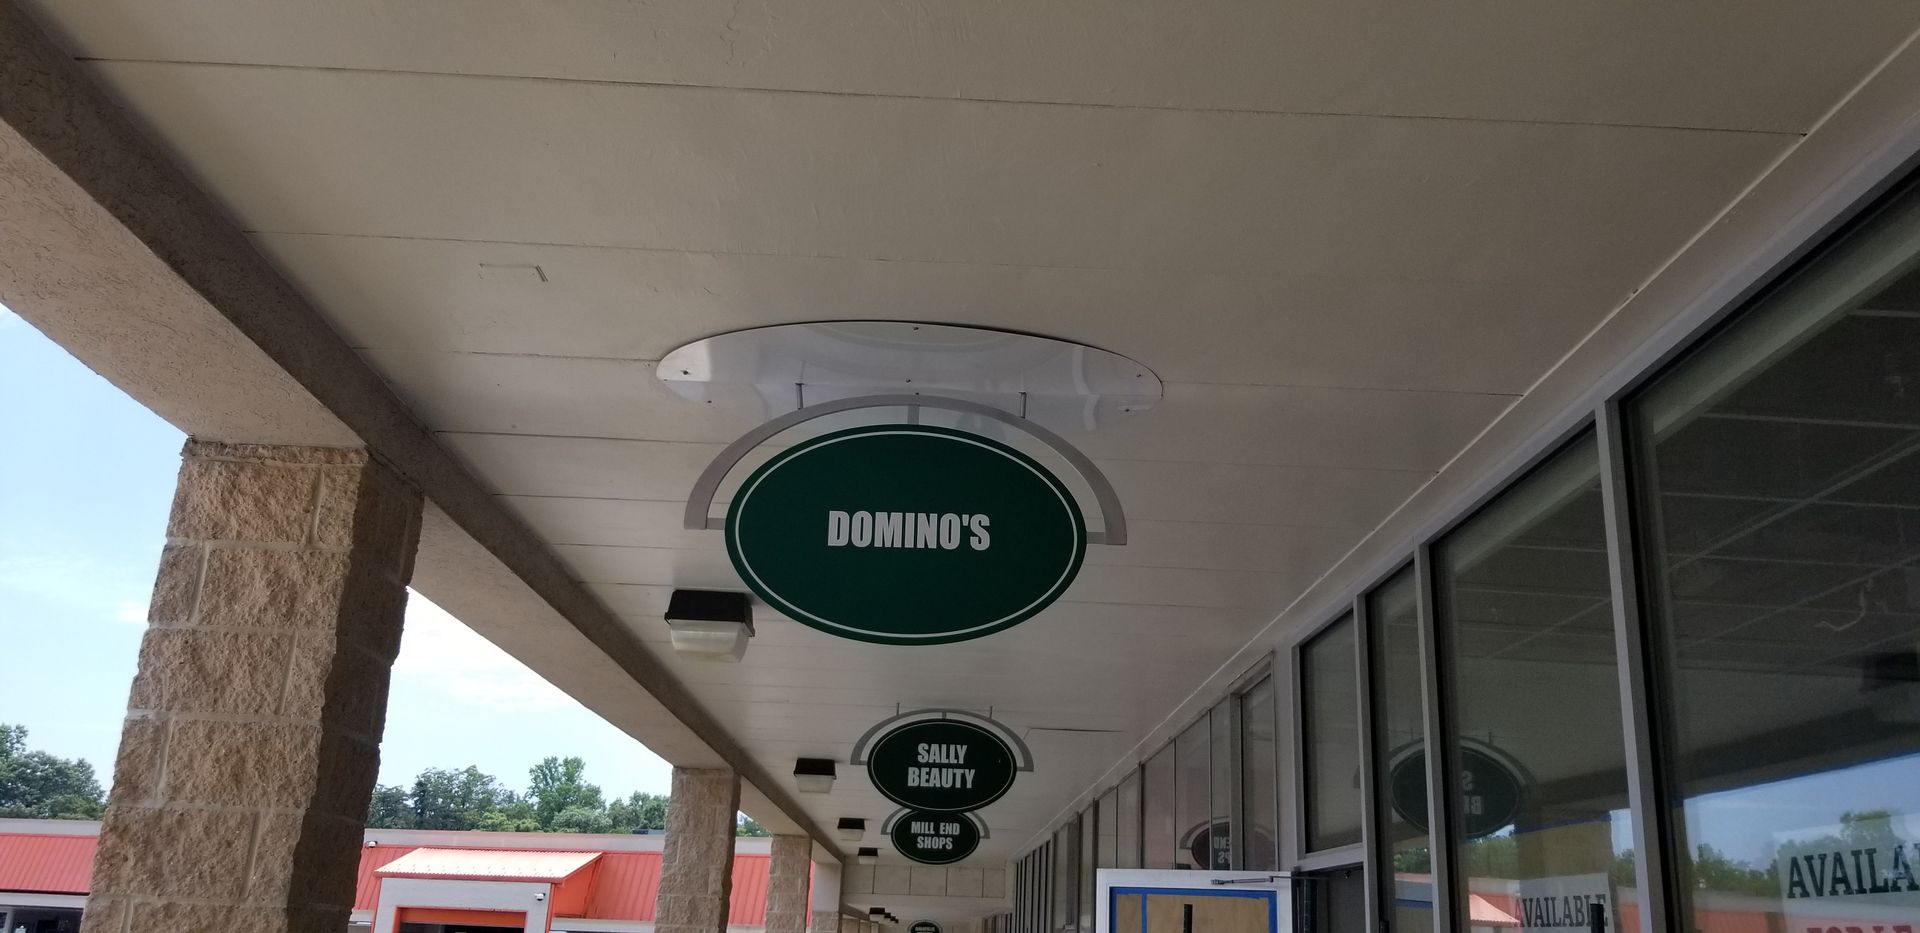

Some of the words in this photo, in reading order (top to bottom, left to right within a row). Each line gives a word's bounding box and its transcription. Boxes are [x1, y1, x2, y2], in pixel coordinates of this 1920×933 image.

[827, 511, 991, 551] DOMINO'S
[917, 743, 968, 764] SALLY
[907, 767, 976, 789] BEAUTY
[911, 821, 935, 835] MILL
[939, 822, 960, 836] END
[916, 836, 953, 850] SHOPS
[1787, 842, 1920, 899] AVAILA
